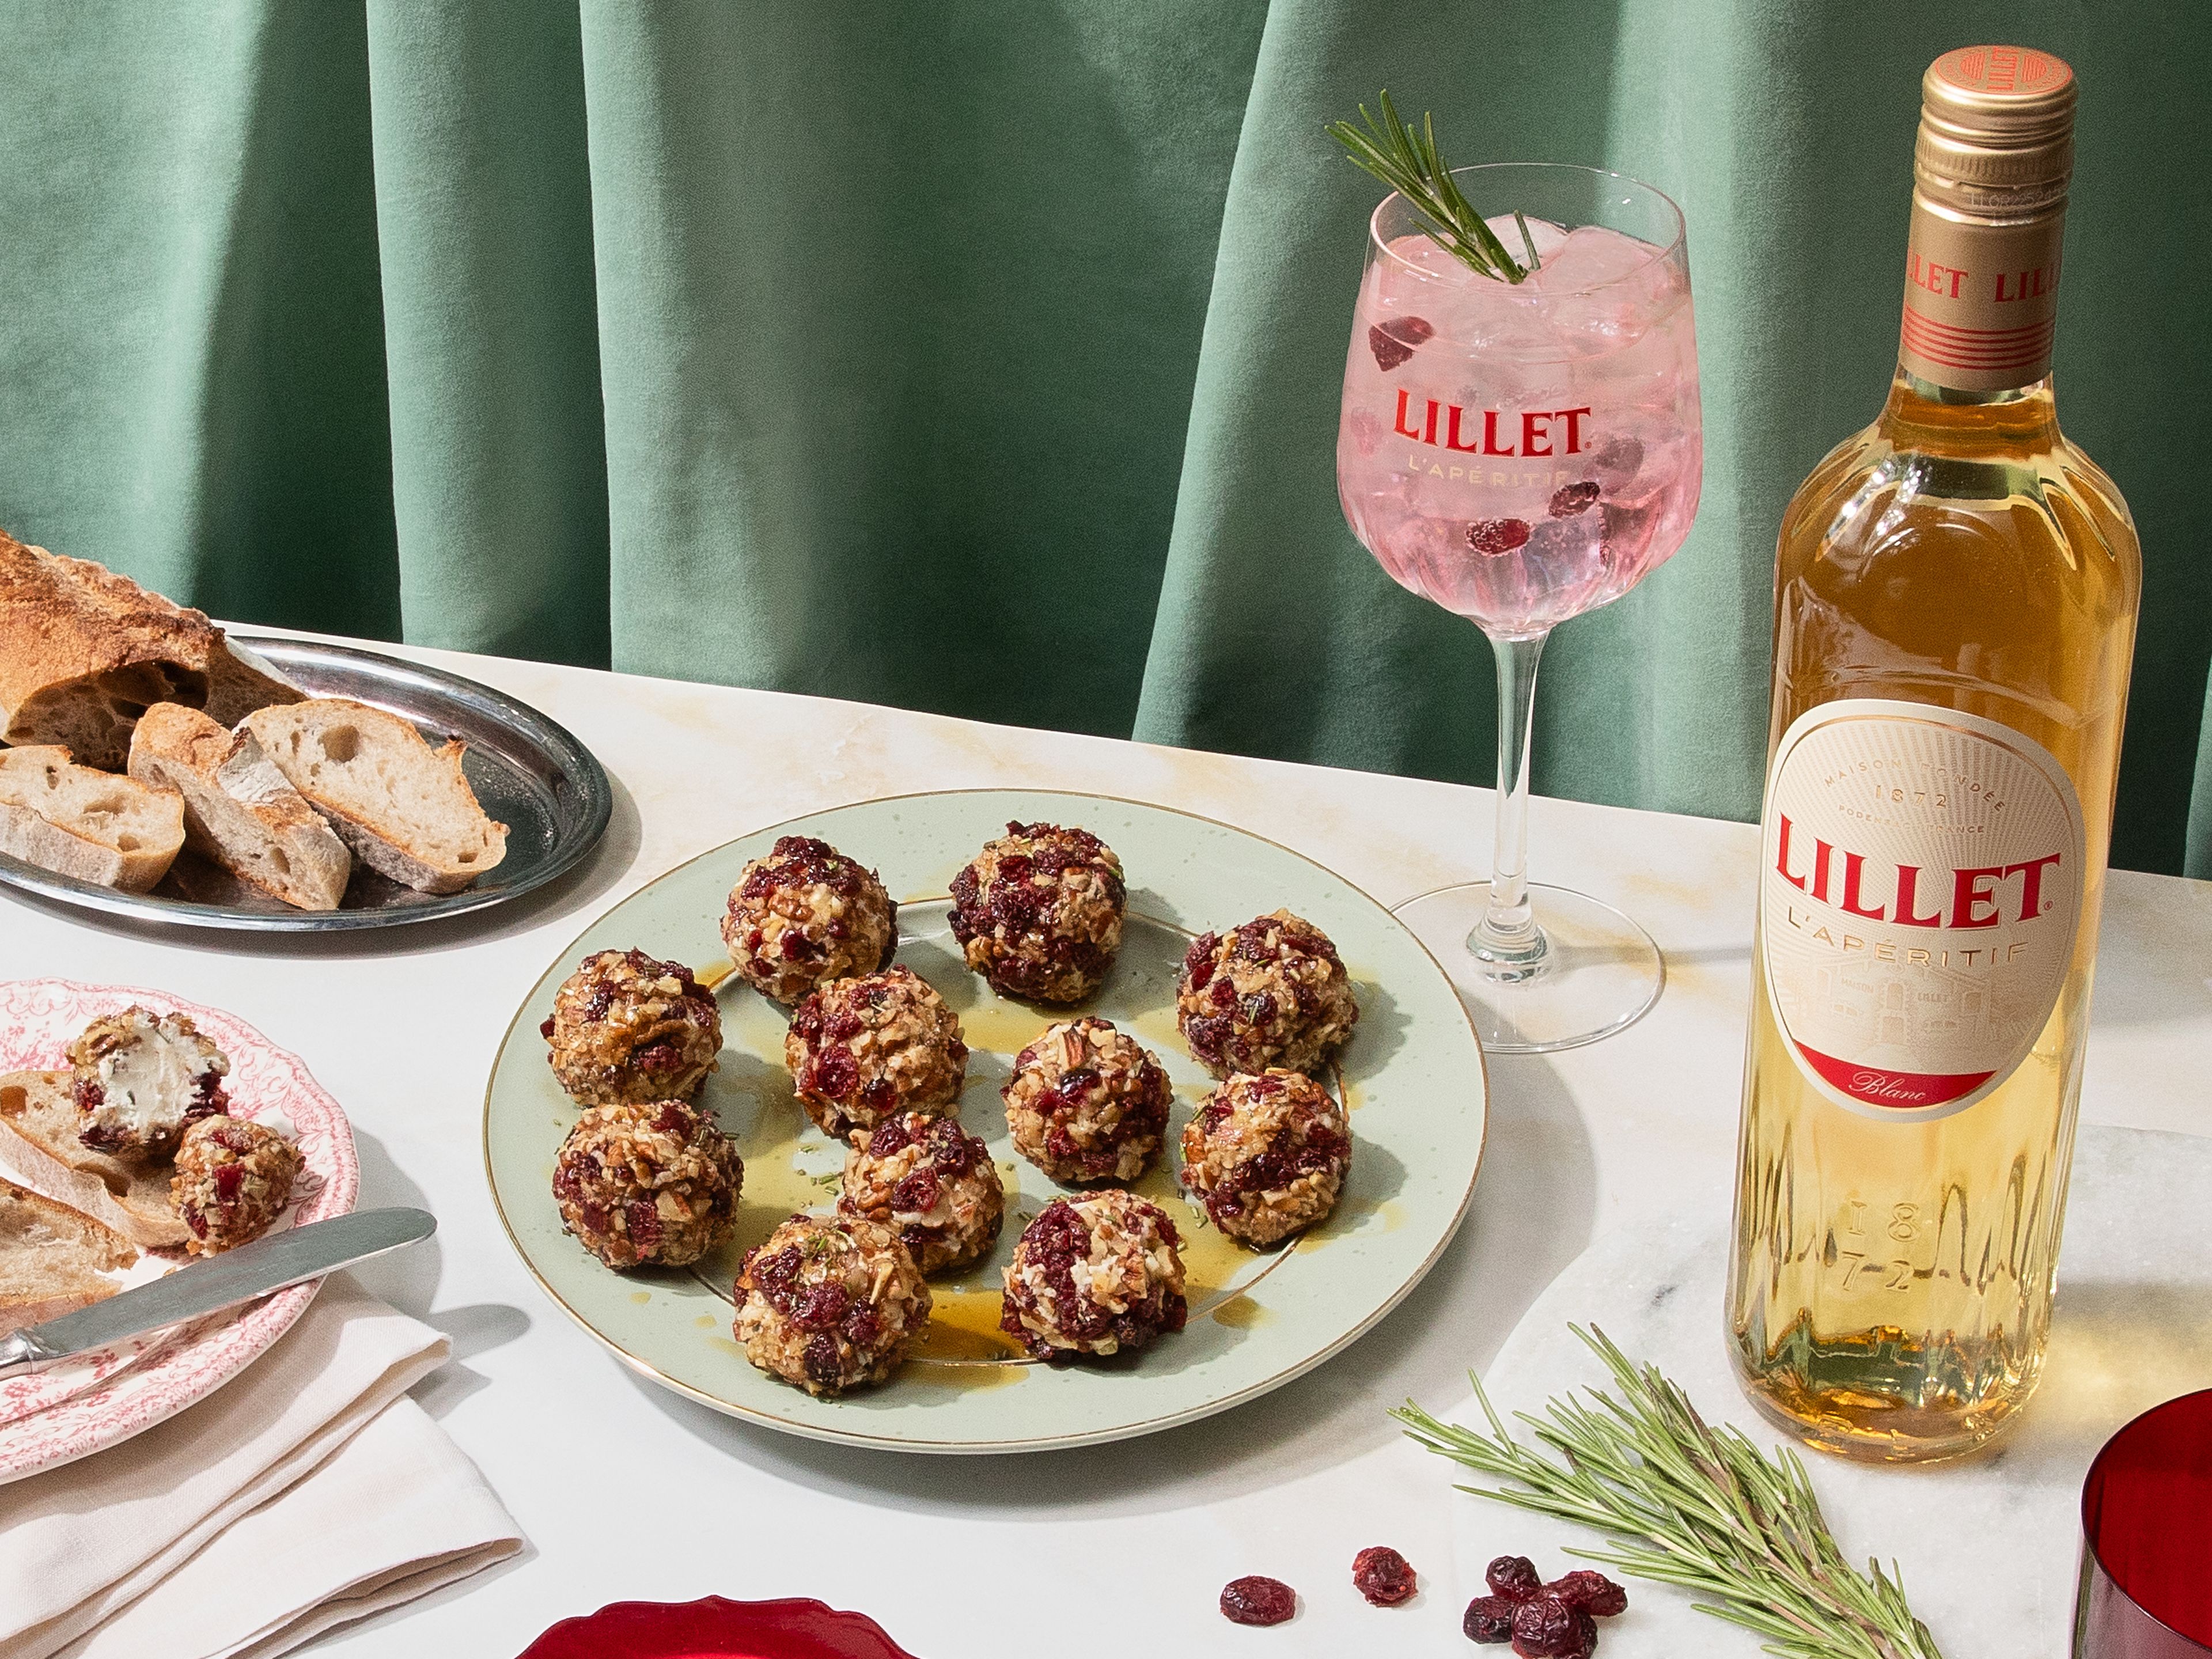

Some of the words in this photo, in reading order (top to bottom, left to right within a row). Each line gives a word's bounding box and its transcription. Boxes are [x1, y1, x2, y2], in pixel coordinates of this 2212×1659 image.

[1987, 46, 2020, 92] LILLET
[1409, 454, 1570, 487] L'APÉRITIF
[1824, 760, 1902, 787] MAISON
[1921, 763, 2006, 812] FONDÉE
[1874, 785, 1946, 807] 1872
[1789, 906, 2029, 967] L'APÉRITIF
[1849, 1070, 1926, 1100] Blanc
[1848, 1200, 1921, 1243] 18
[1842, 1251, 1914, 1294] 72
